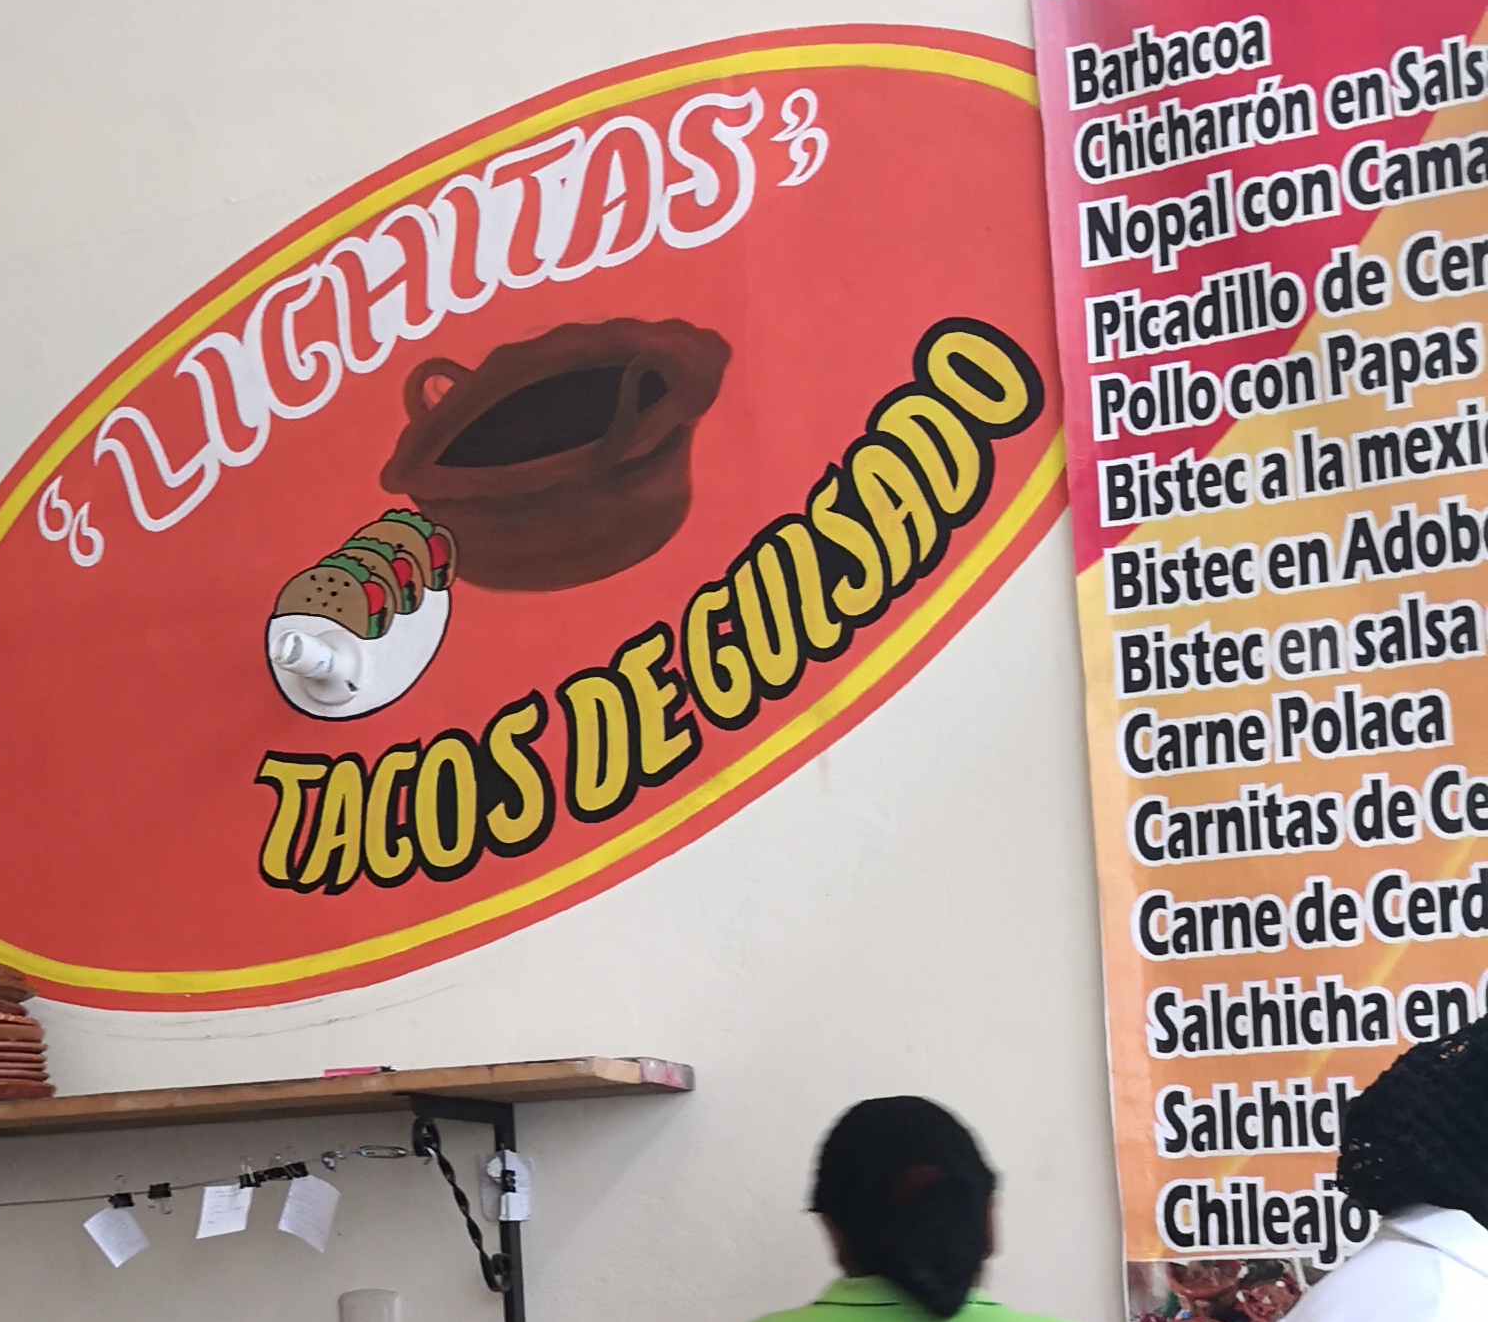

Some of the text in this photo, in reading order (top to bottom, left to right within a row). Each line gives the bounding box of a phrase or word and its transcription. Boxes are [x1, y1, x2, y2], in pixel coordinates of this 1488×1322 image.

[1069, 15, 1268, 108] Barbacoa
[1077, 40, 1488, 183] Chicharrón en Sals
[1083, 133, 1488, 270] Nopal con Cama
[1090, 233, 1488, 361] Picadillo de Cer
[1095, 324, 1480, 438] Pollo con Papas
[1103, 401, 1488, 523] Bistec a la mexi
[255, 316, 1044, 893] TACOS DE GUISADO
[1108, 499, 1488, 612] Bistec en Adob
[1117, 595, 1481, 697] Bistec en salsa
[1121, 687, 1448, 776] Carne Polaca
[1131, 786, 1340, 864] Carnitas
[1351, 776, 1417, 844] de
[1136, 891, 1285, 958] Carne
[1293, 878, 1360, 947] de
[1150, 978, 1472, 1057] Salchicha en
[1160, 1178, 1374, 1267] Chileajo
